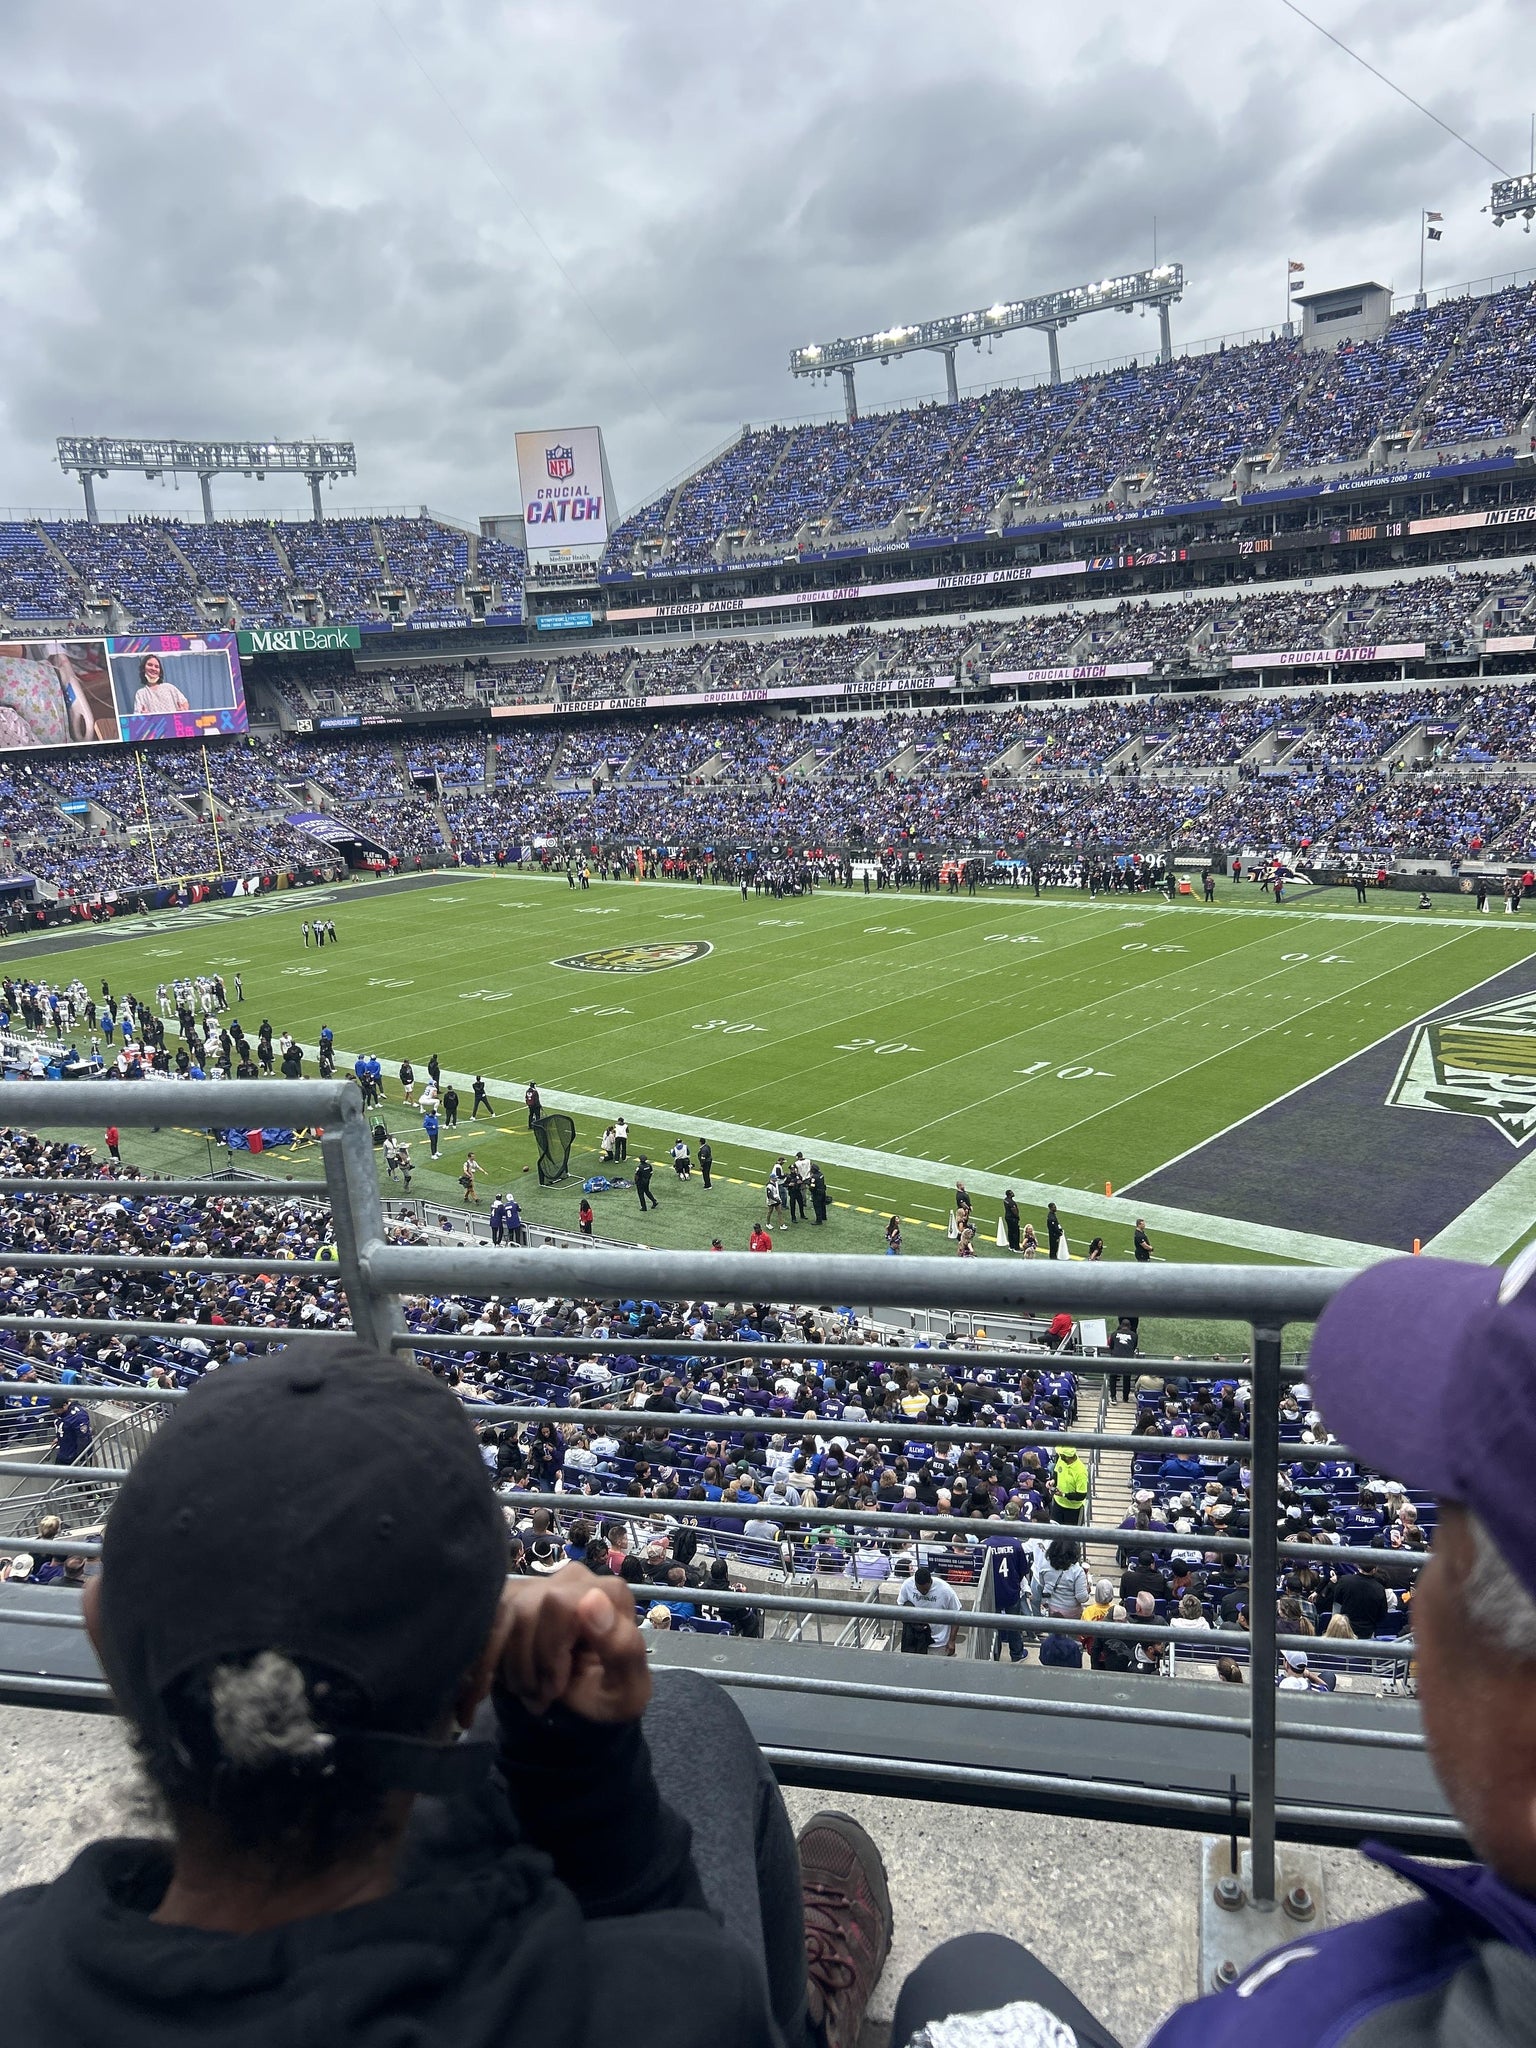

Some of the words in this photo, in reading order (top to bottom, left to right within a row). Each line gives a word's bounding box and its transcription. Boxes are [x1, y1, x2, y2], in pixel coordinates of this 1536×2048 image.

[549, 460, 572, 477] NFL
[1337, 483, 1350, 491] AFC
[1351, 477, 1390, 490] CHAMPIONS
[1390, 475, 1408, 484] 2000
[1413, 471, 1431, 480] 2012
[537, 485, 590, 499] CRUCIAL
[527, 496, 602, 525] CATCH
[1062, 520, 1082, 528] WORLD
[1082, 515, 1114, 526] CHAMPIONS
[1125, 512, 1139, 520] 2000
[1150, 508, 1165, 516] 2012
[1346, 526, 1377, 542] TIMEOUT
[1386, 523, 1402, 537] 1:18
[867, 545, 882, 554] RING
[887, 542, 910, 552] HONOR
[1238, 541, 1253, 555] 7:22
[1255, 540, 1268, 553] QTR
[1269, 539, 1273, 551] 1
[572, 553, 591, 561] Health
[1118, 557, 1124, 567] 0
[1171, 550, 1176, 562] 3
[651, 570, 673, 578] MARSHAL
[674, 568, 690, 576] YANDA
[937, 573, 988, 588] INTERCEPT
[992, 568, 1032, 582] CANCER
[656, 603, 704, 616] INTERCEPT
[708, 600, 744, 611] CANCER
[796, 592, 830, 602] CRUCIAL
[832, 587, 859, 600] CATCH
[249, 630, 301, 652] M&T
[302, 628, 351, 650] Bank
[1280, 651, 1331, 664] CRUCIAL
[1334, 646, 1377, 661] CATCH
[1028, 669, 1070, 681] CRUCIAL
[1072, 666, 1106, 679] CATCH
[843, 680, 893, 694] INTERCEPT
[897, 677, 935, 690] CANCER
[553, 700, 605, 713] INTERCEPT
[609, 697, 647, 710] CANCER
[703, 693, 739, 702] CRUCIAL
[741, 690, 768, 701] CATCH
[367, 858, 386, 867] RAVEN
[758, 919, 804, 927] 50
[863, 926, 917, 935] 40
[983, 933, 1040, 943] 30
[1121, 942, 1182, 953] 20
[1280, 952, 1346, 964] 10
[281, 967, 328, 976] 30
[366, 977, 415, 988] 40
[459, 989, 512, 1001] 50
[569, 1004, 626, 1016] 40
[692, 1019, 755, 1034] 30
[834, 1038, 908, 1055] 20
[1014, 1061, 1094, 1080] 10
[964, 1369, 973, 1379] 14
[932, 1461, 945, 1470] REED
[1355, 1514, 1376, 1524] FLOWERS
[991, 1546, 1014, 1555] FLOWERS
[998, 1558, 1009, 1578] 4
[913, 1592, 937, 1602] Plymouth
[701, 1604, 722, 1621] 55
